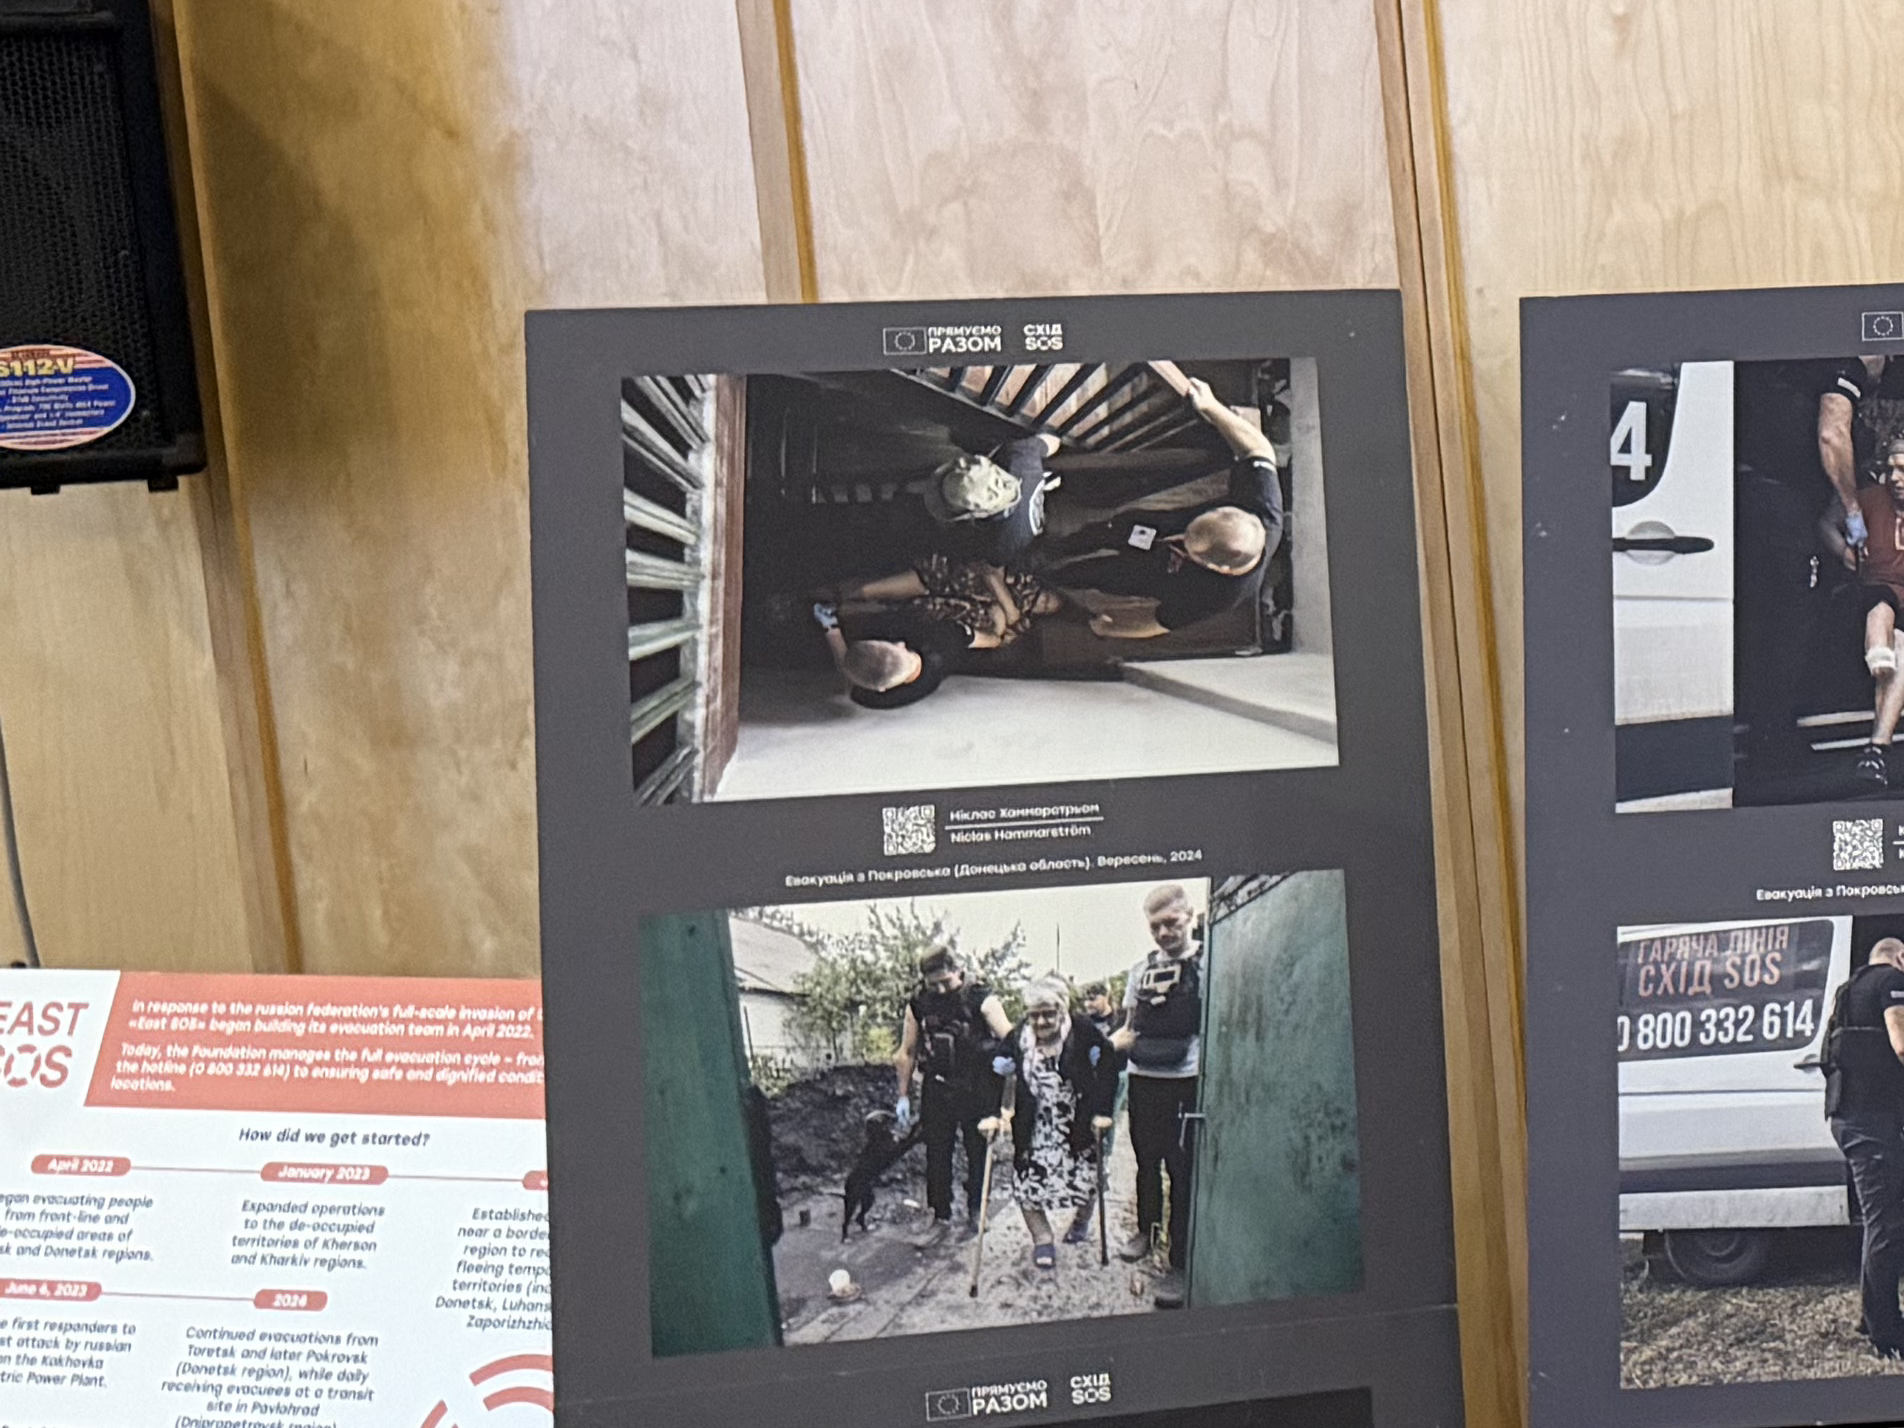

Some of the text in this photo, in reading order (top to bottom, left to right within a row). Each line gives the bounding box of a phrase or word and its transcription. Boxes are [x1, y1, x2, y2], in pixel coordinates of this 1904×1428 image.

[928, 325, 1002, 336] ПРЯМУЄМО
[1023, 323, 1063, 336] СХІД
[929, 337, 1002, 352] РАЗОМ
[1025, 337, 1063, 351] SOS
[1610, 401, 1652, 481] 4
[1756, 885, 1822, 902] Евакуація
[1637, 925, 1789, 965] ГАРЯЧА ЛІНІЯ
[1638, 952, 1782, 998] СХІД SOS
[1637, 1010, 1692, 1051] 800
[1699, 1005, 1756, 1046] 332
[1762, 999, 1815, 1042] 614
[0, 1044, 73, 1089] OS
[238, 1127, 430, 1147] How did we get started?
[48, 1155, 114, 1174] April 2022
[278, 1165, 371, 1184] January 2023
[241, 1199, 385, 1217] Expanded operations
[243, 1217, 375, 1236] to the de-occupied
[232, 1234, 377, 1251] territories of Kherson
[230, 1251, 366, 1272] and Kharkiv regions.
[185, 1326, 378, 1346] Continued evacuations from
[188, 1343, 367, 1364] Toretsk and later Pokrovsk
[175, 1361, 369, 1385] (Donetsk region), while daily
[1070, 1373, 1111, 1388] СХІД
[973, 1394, 1047, 1416] РАЗОМ
[1071, 1387, 1111, 1405] SOS
